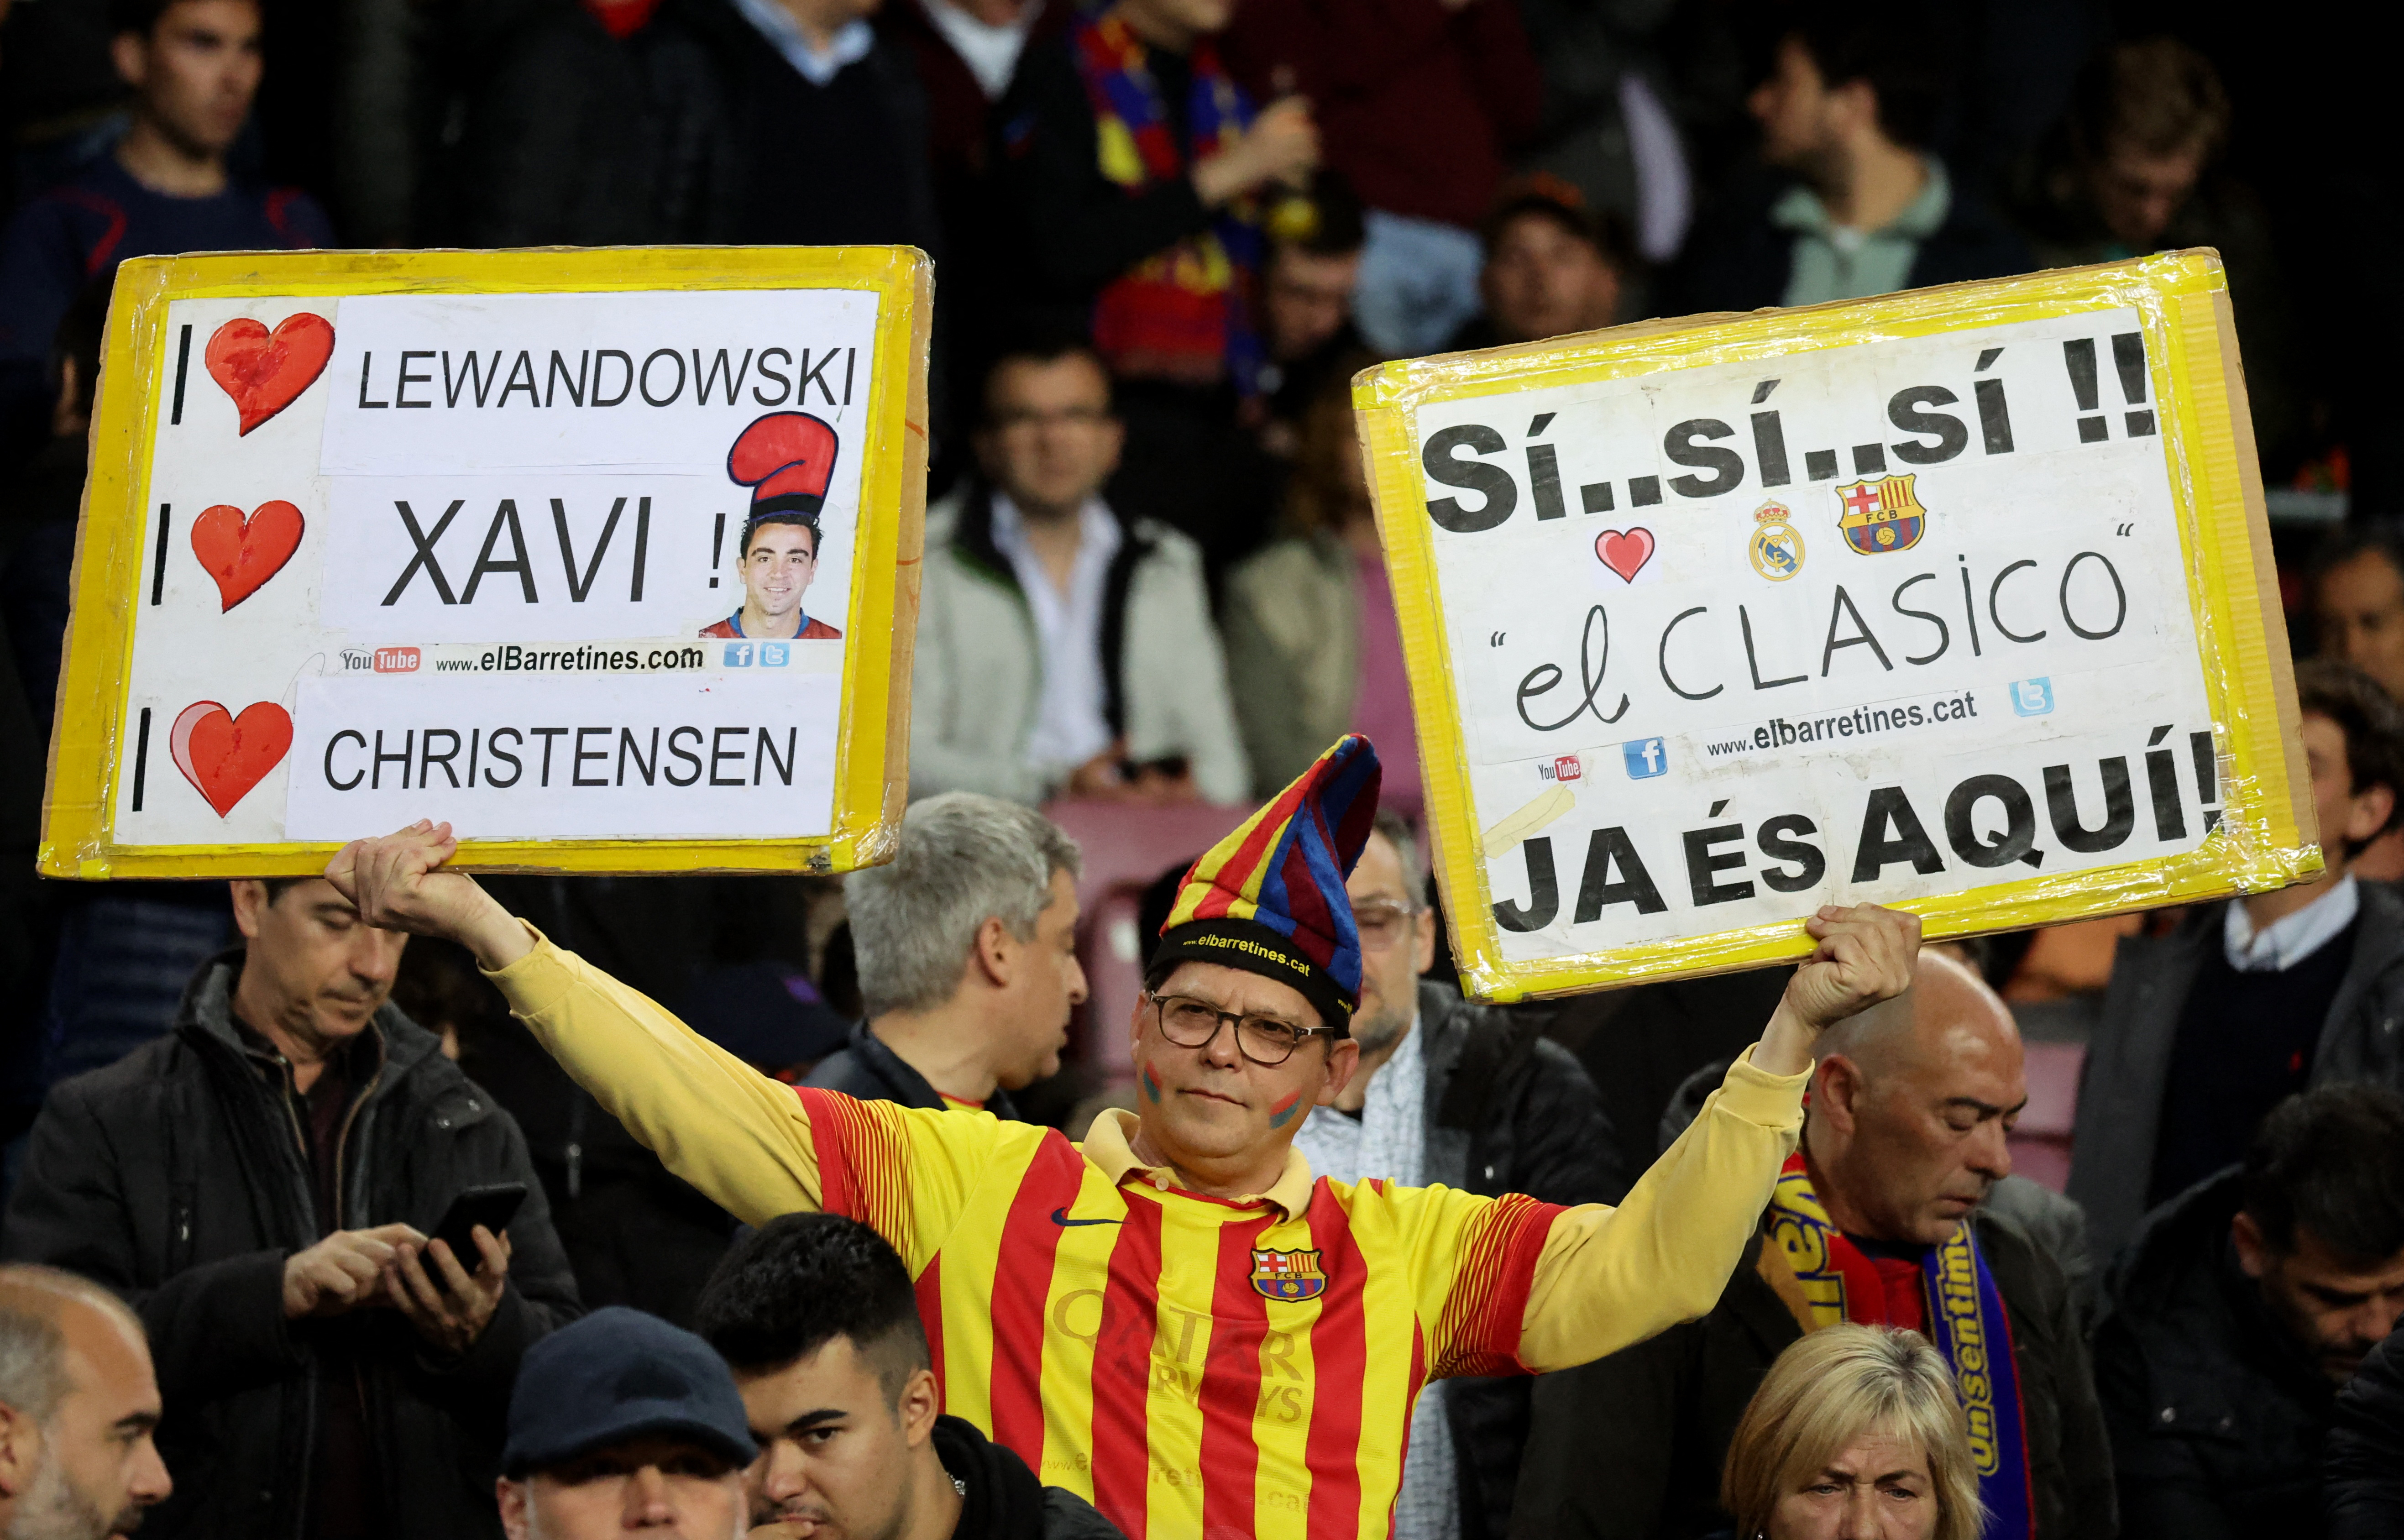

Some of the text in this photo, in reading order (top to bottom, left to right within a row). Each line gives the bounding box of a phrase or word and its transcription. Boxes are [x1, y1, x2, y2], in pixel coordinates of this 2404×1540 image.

[171, 324, 856, 425] I LEWANDOWSKI
[151, 503, 171, 606] I
[381, 497, 652, 606] XAVI
[436, 645, 703, 671] www.elBarretines.com
[131, 707, 797, 812] I CHRISTENSEN
[1707, 691, 1978, 756] www.elbarretines.cat
[1492, 826, 1669, 933] JA
[1682, 799, 1826, 907] ÉS
[1183, 934, 1310, 977] www.elbarretines.cat
